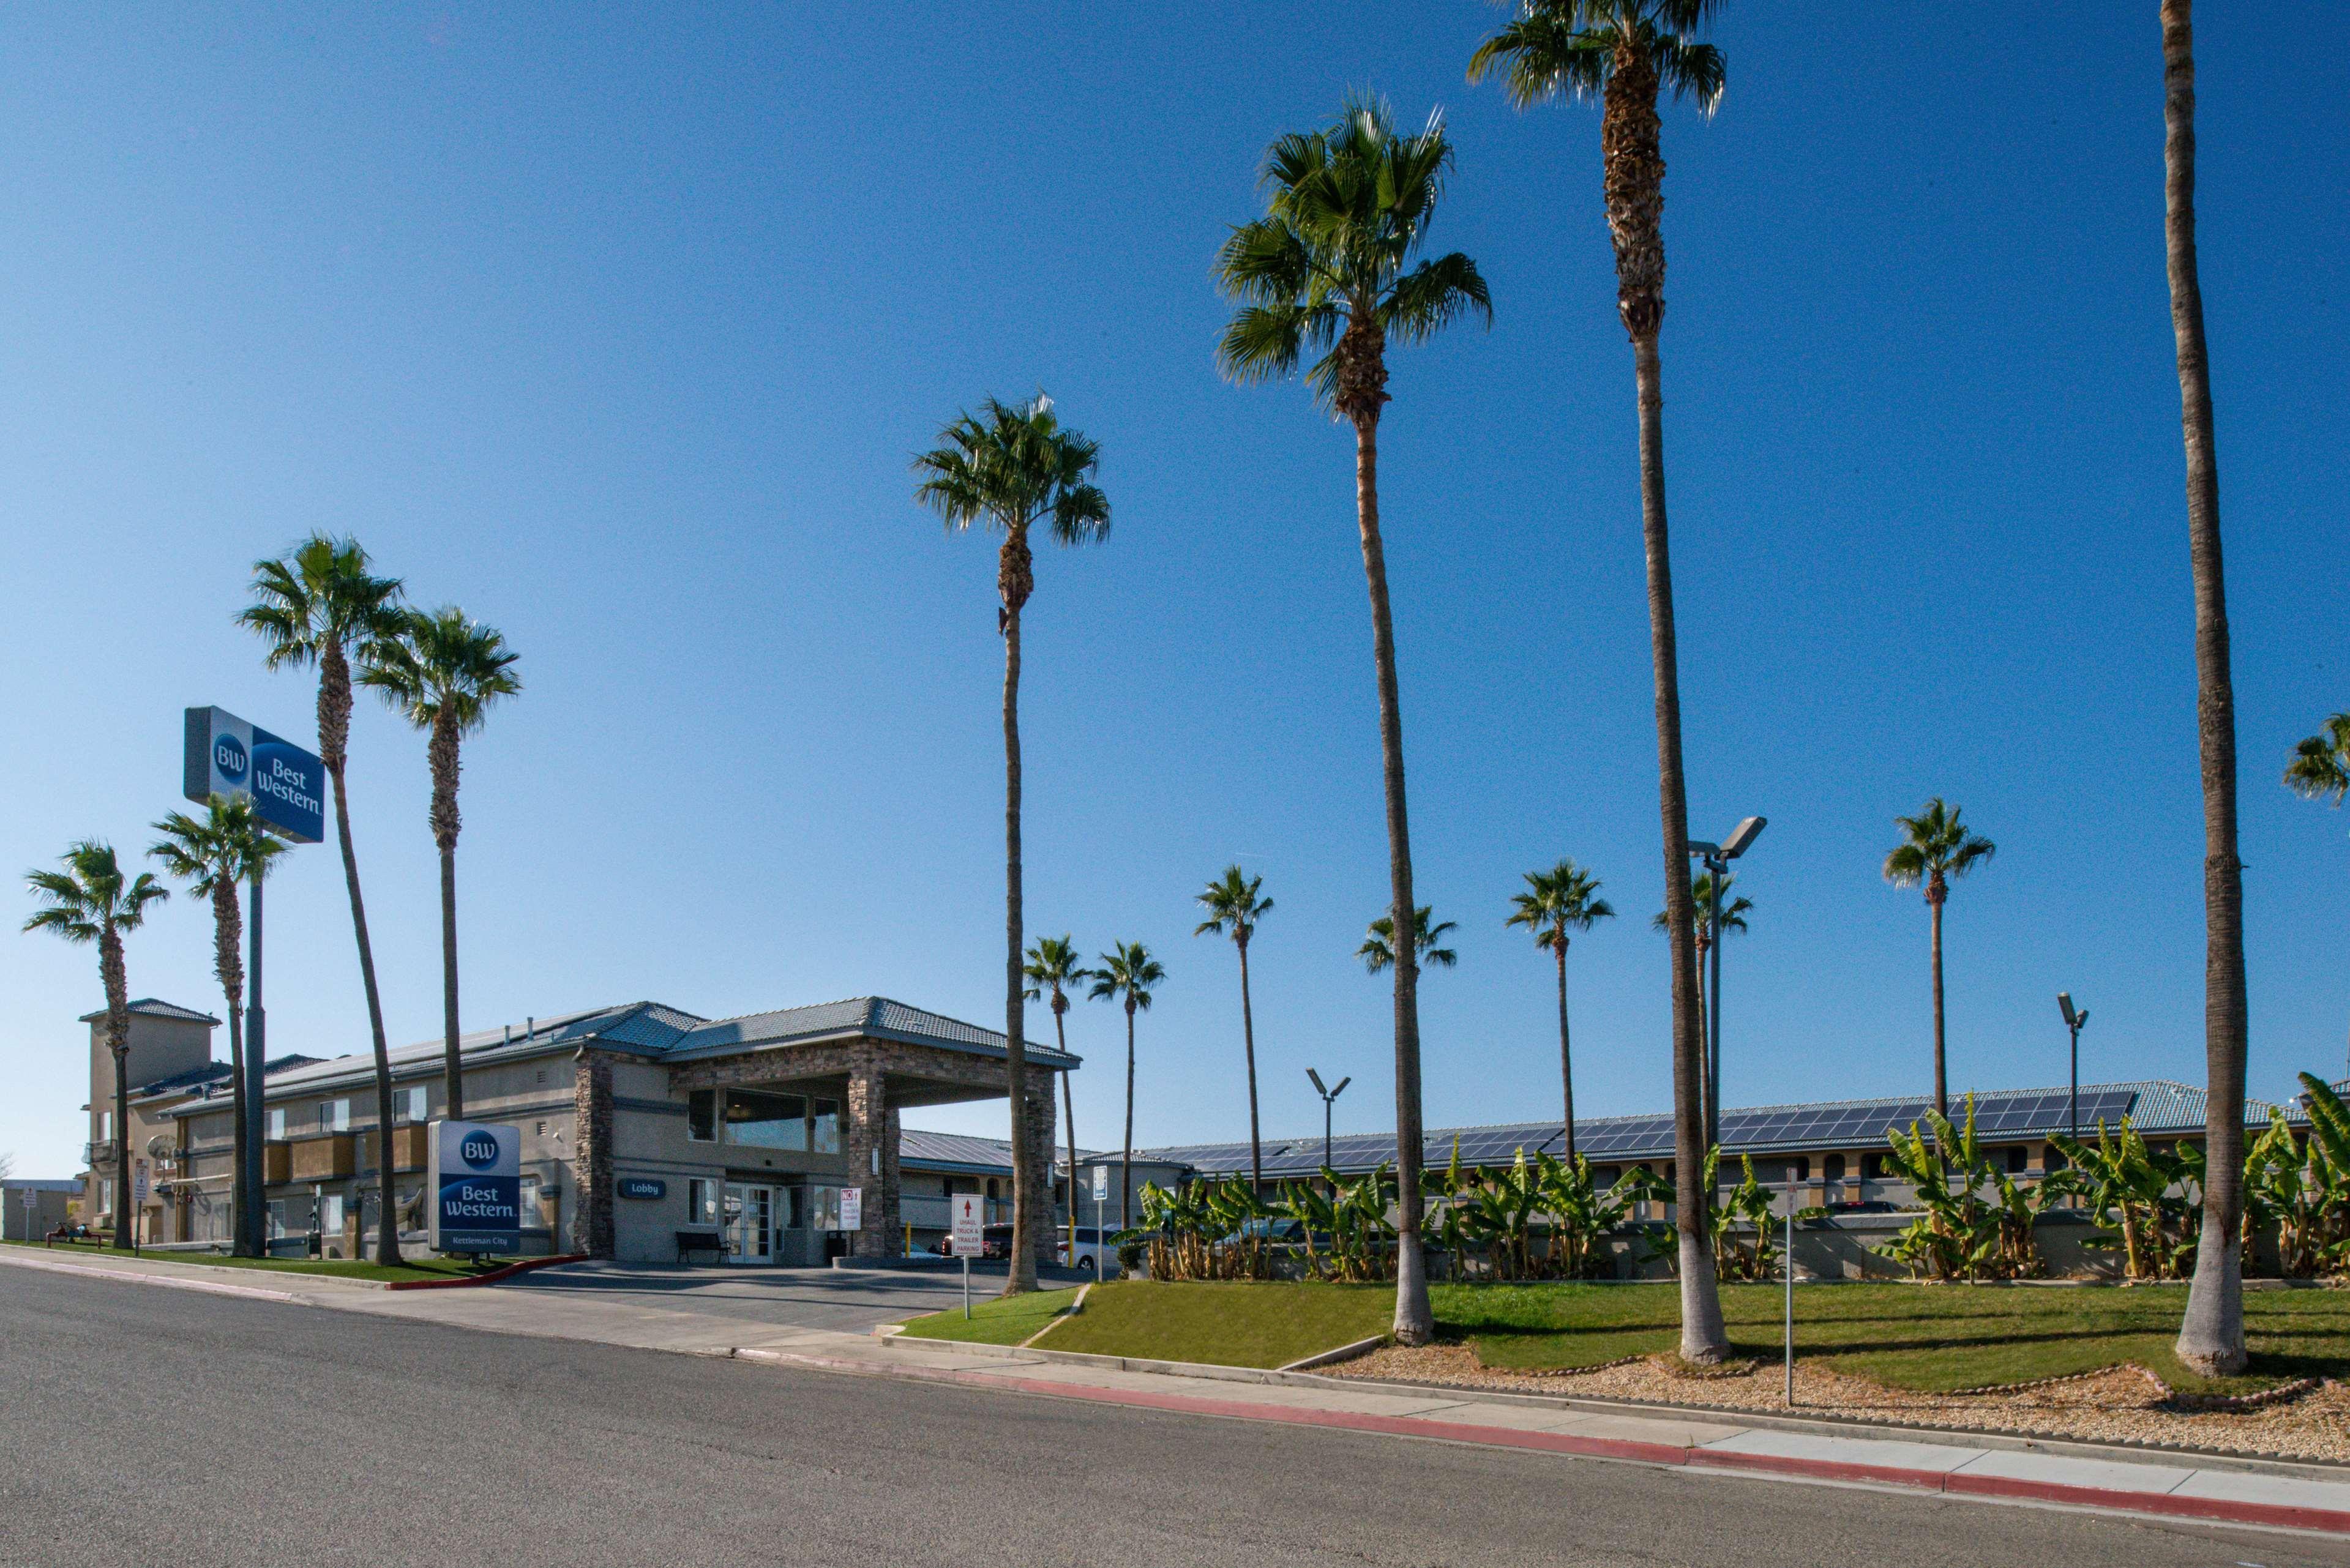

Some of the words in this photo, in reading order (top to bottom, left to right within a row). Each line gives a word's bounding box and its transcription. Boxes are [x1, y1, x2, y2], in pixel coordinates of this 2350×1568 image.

[217, 745, 245, 773] BW
[273, 758, 306, 790] Best
[256, 770, 320, 815] Western
[465, 1142, 495, 1159] BW
[462, 1185, 499, 1201] Best
[632, 1183, 659, 1195] Lobby
[842, 1191, 852, 1200] NO
[446, 1201, 513, 1217] Western
[492, 1238, 507, 1246] City
